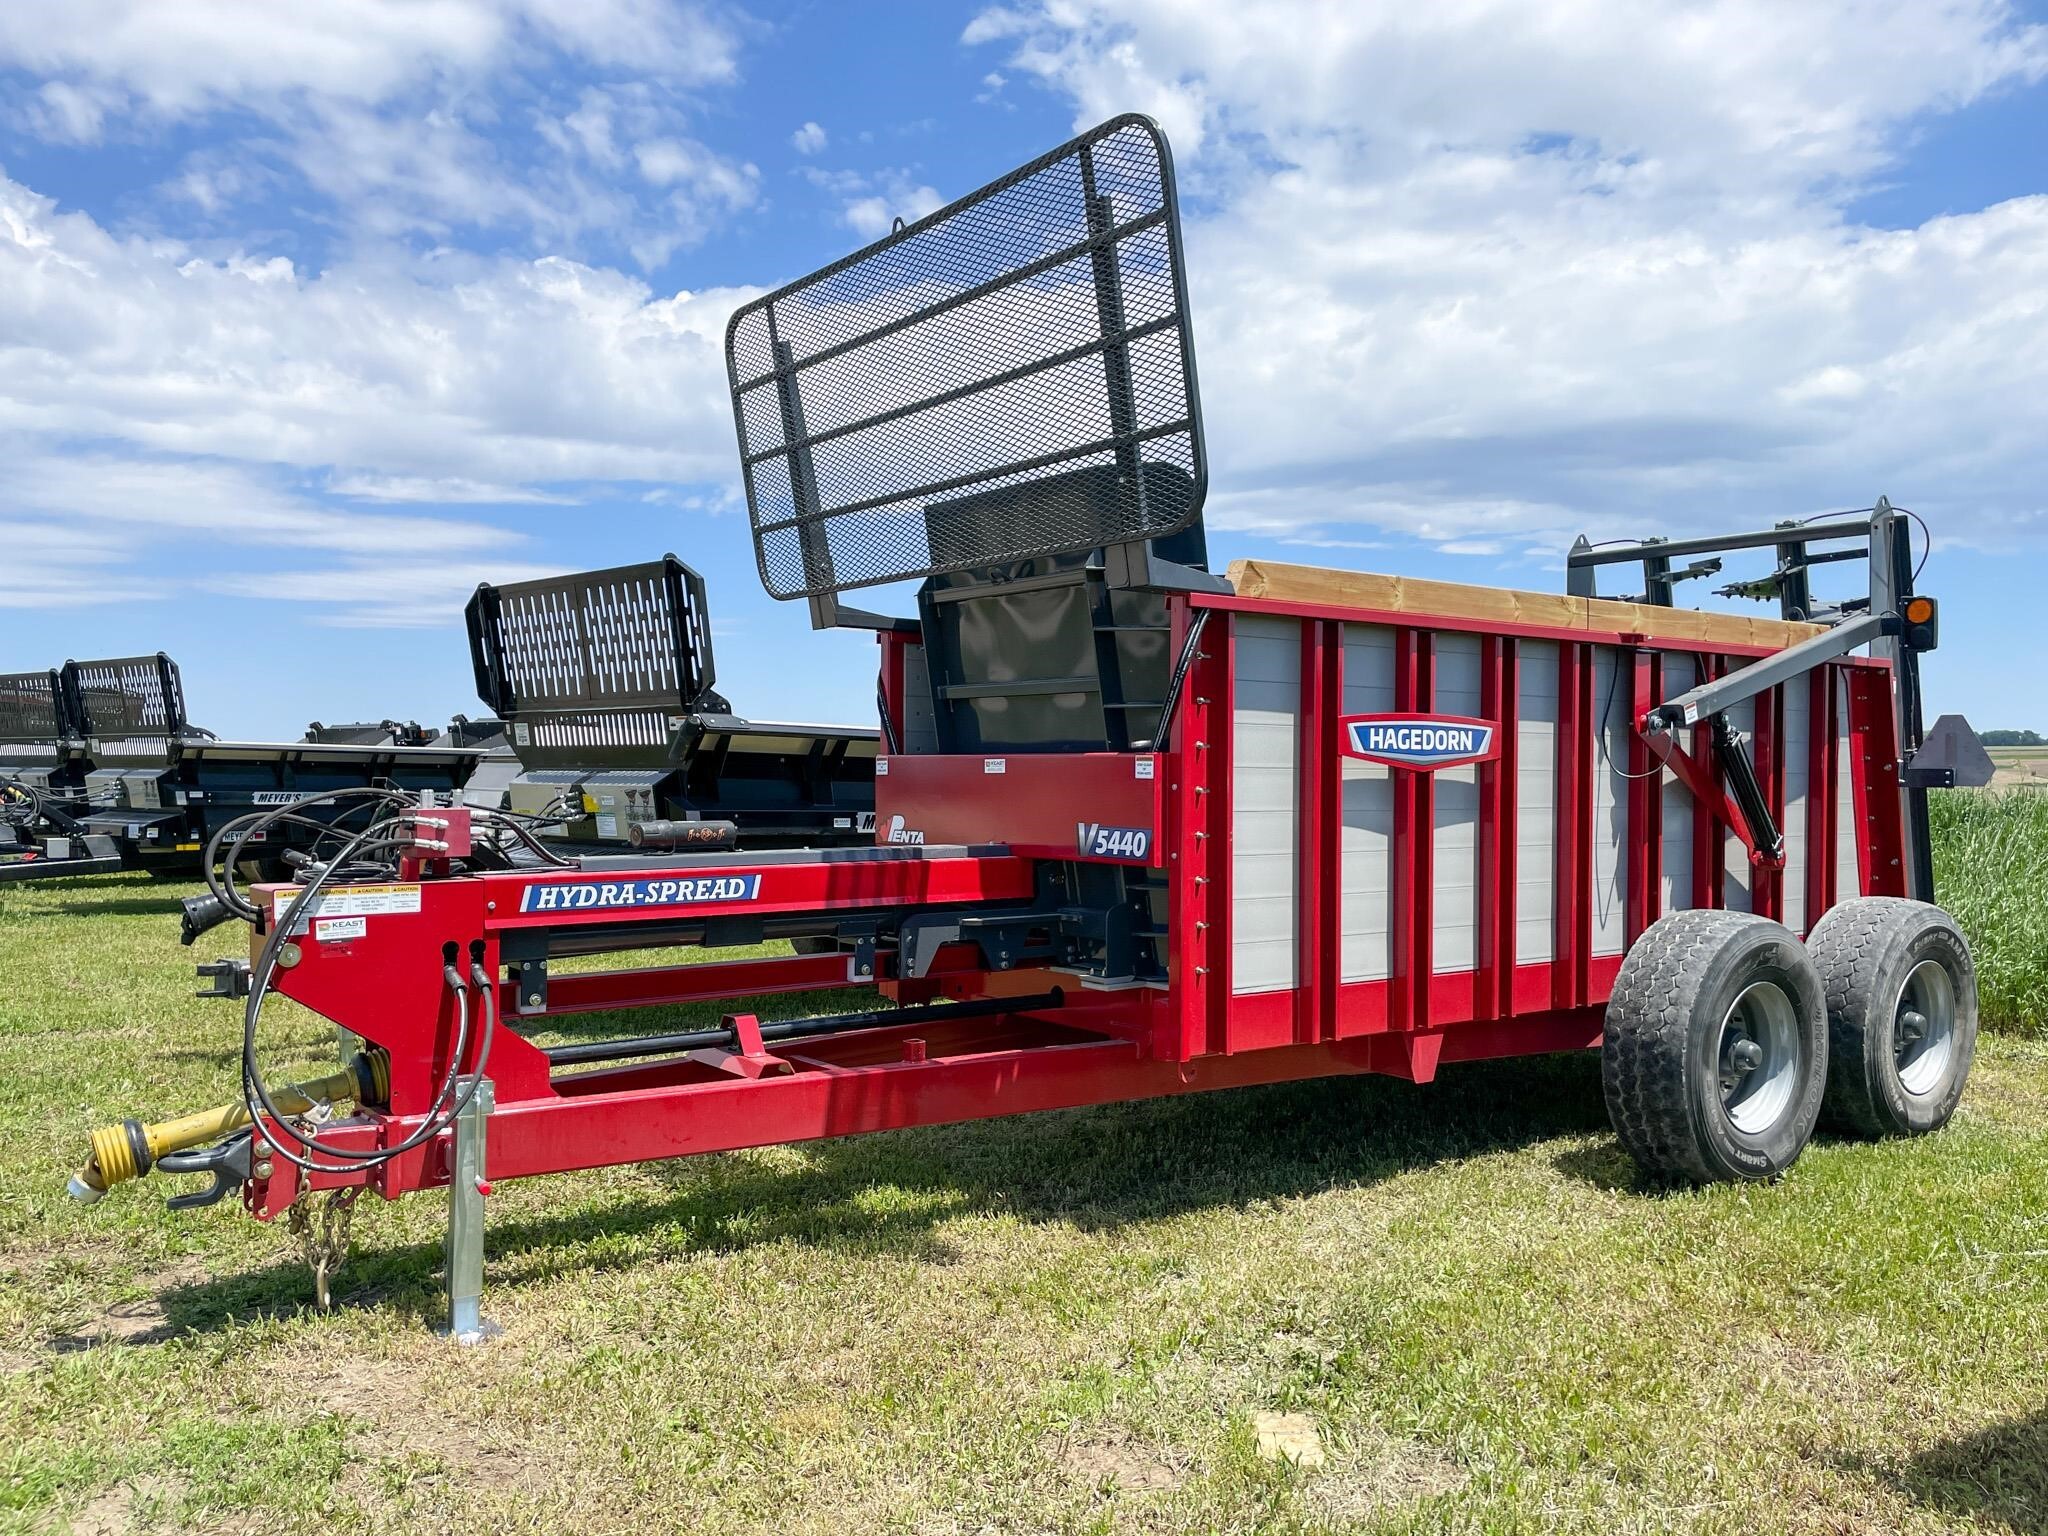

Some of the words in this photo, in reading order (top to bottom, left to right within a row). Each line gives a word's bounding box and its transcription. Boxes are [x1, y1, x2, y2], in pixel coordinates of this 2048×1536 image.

[1369, 727, 1473, 751] HAGEDORN
[258, 793, 302, 803] MEYER'S
[888, 814, 925, 845] PENTA
[1077, 822, 1147, 858] V5440
[536, 878, 746, 909] HYDRA-SPREAD
[332, 919, 365, 928] KEAST
